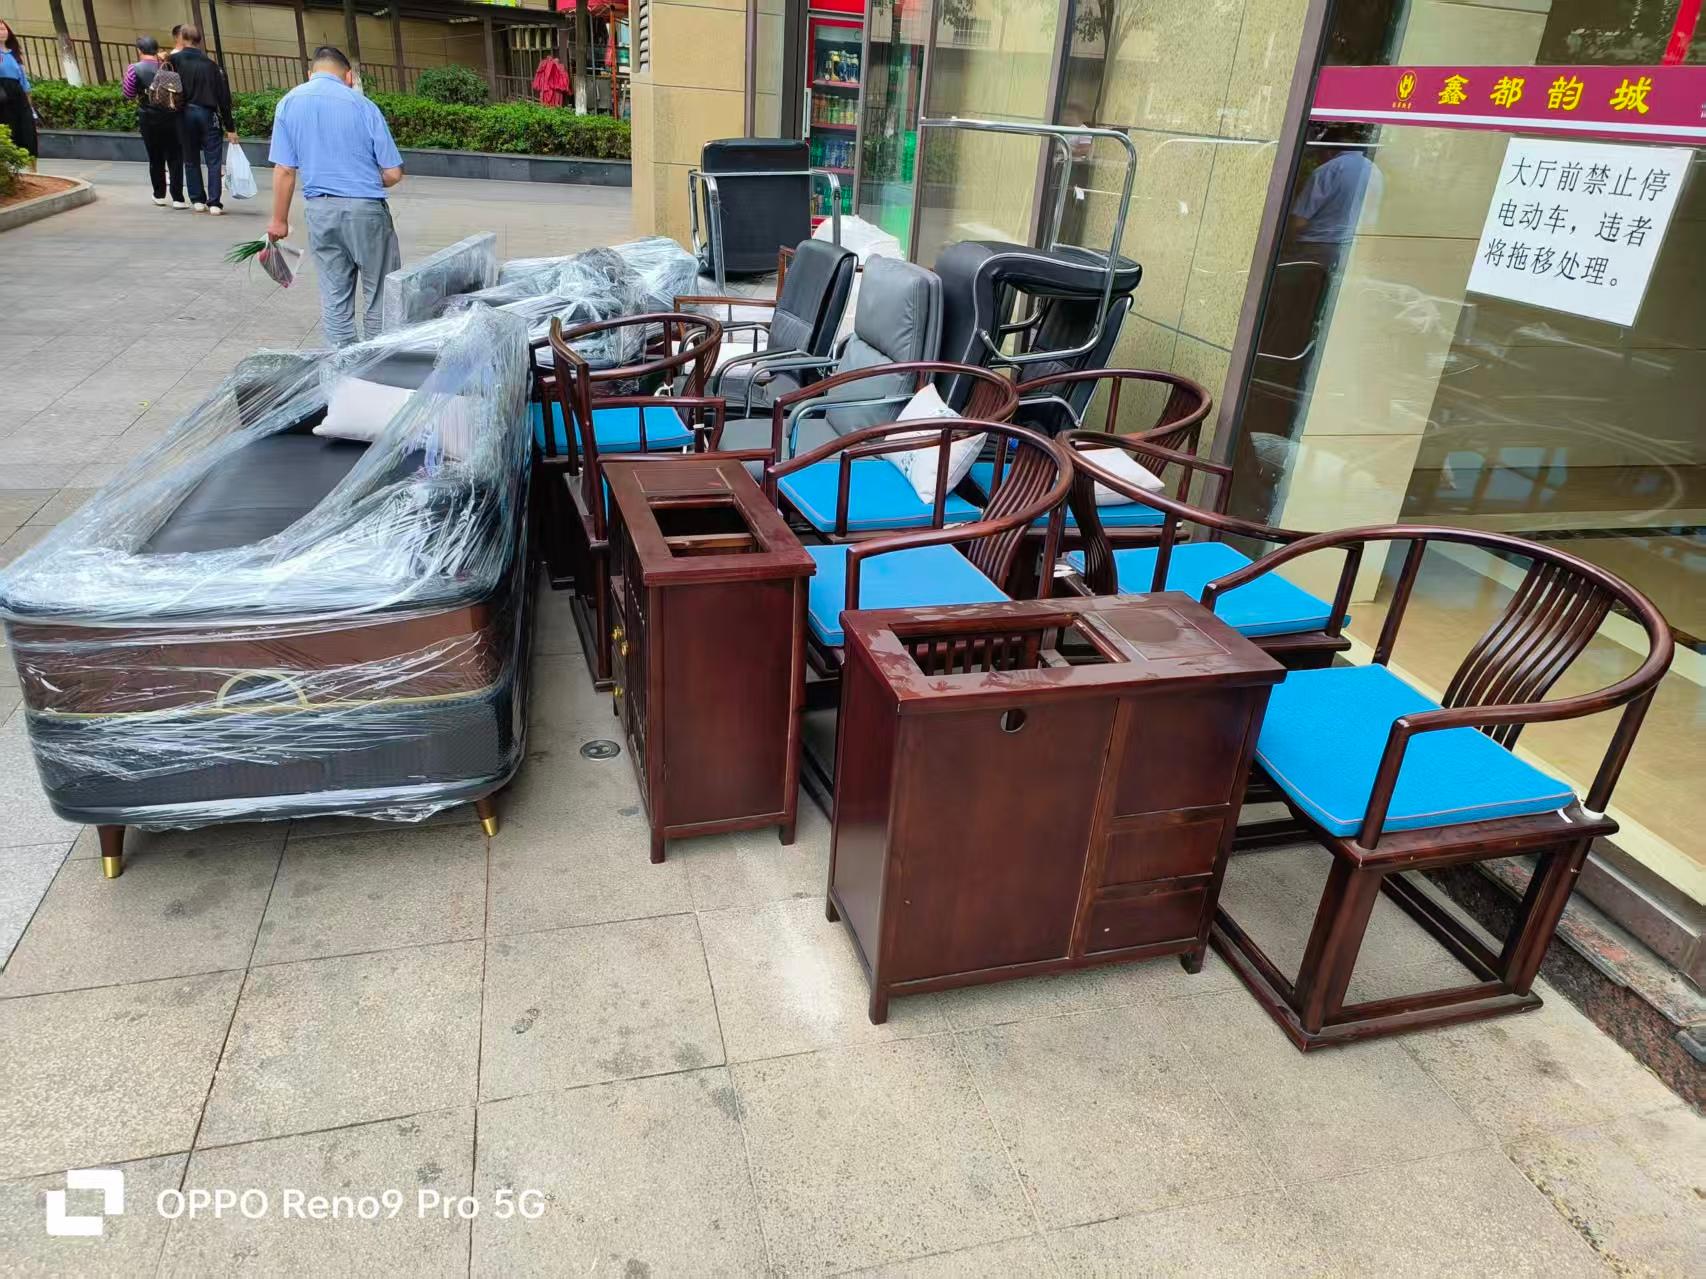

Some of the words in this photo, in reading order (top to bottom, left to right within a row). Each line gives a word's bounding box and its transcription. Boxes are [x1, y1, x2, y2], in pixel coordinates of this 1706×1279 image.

[1438, 74, 1652, 114] 鑫都韵城
[1506, 156, 1671, 202] 大厅前禁止停
[1484, 237, 1619, 288] 将拖移处理。
